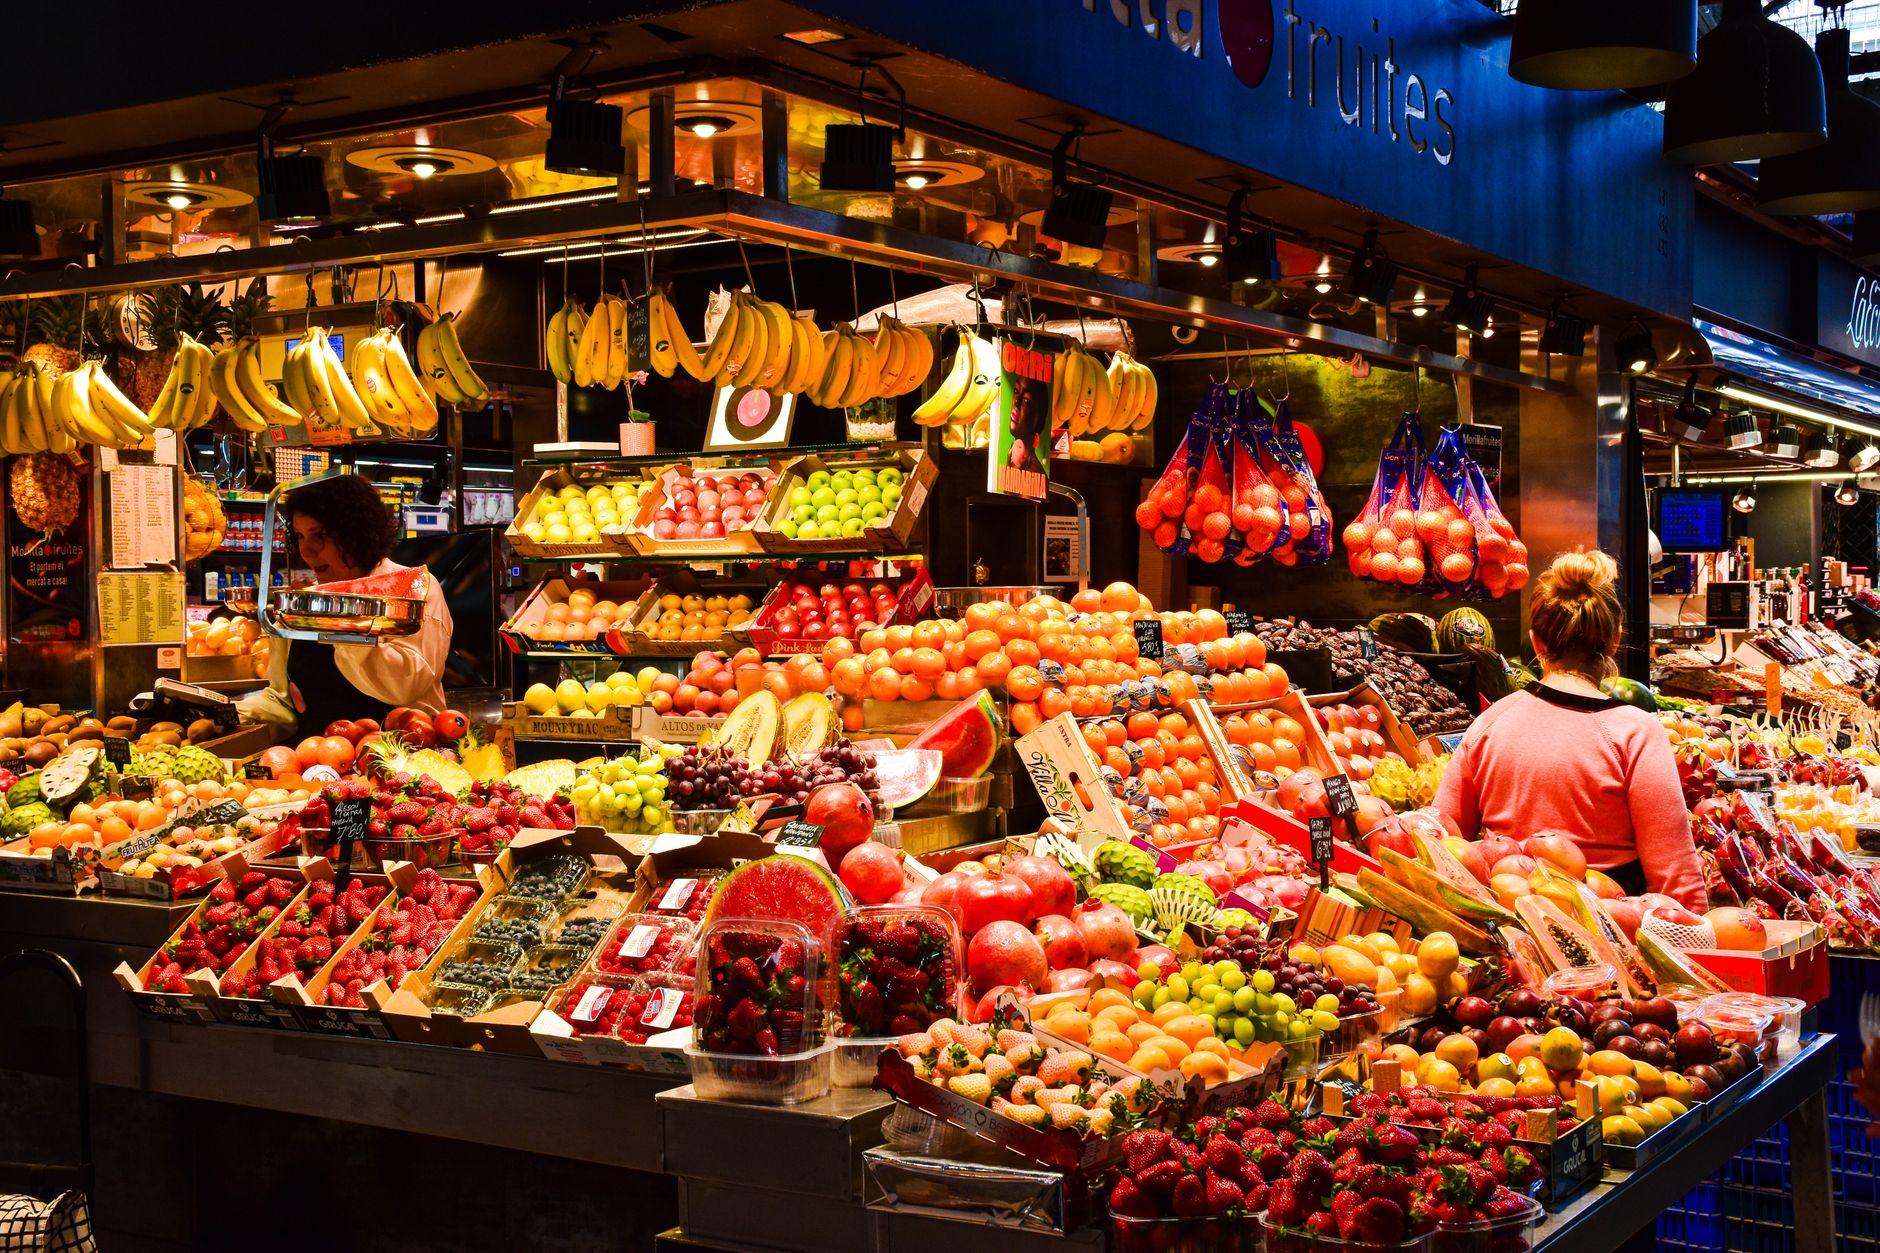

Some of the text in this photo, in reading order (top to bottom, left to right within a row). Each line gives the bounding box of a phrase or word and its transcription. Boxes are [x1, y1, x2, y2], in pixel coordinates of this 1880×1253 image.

[1285, 0, 1454, 165] fruites
[771, 640, 802, 654] Pink
[532, 721, 599, 734] MOUNEYRAC
[661, 721, 695, 732] ALTOS
[1058, 724, 1072, 748] EXTRA
[1027, 751, 1054, 795] Villa
